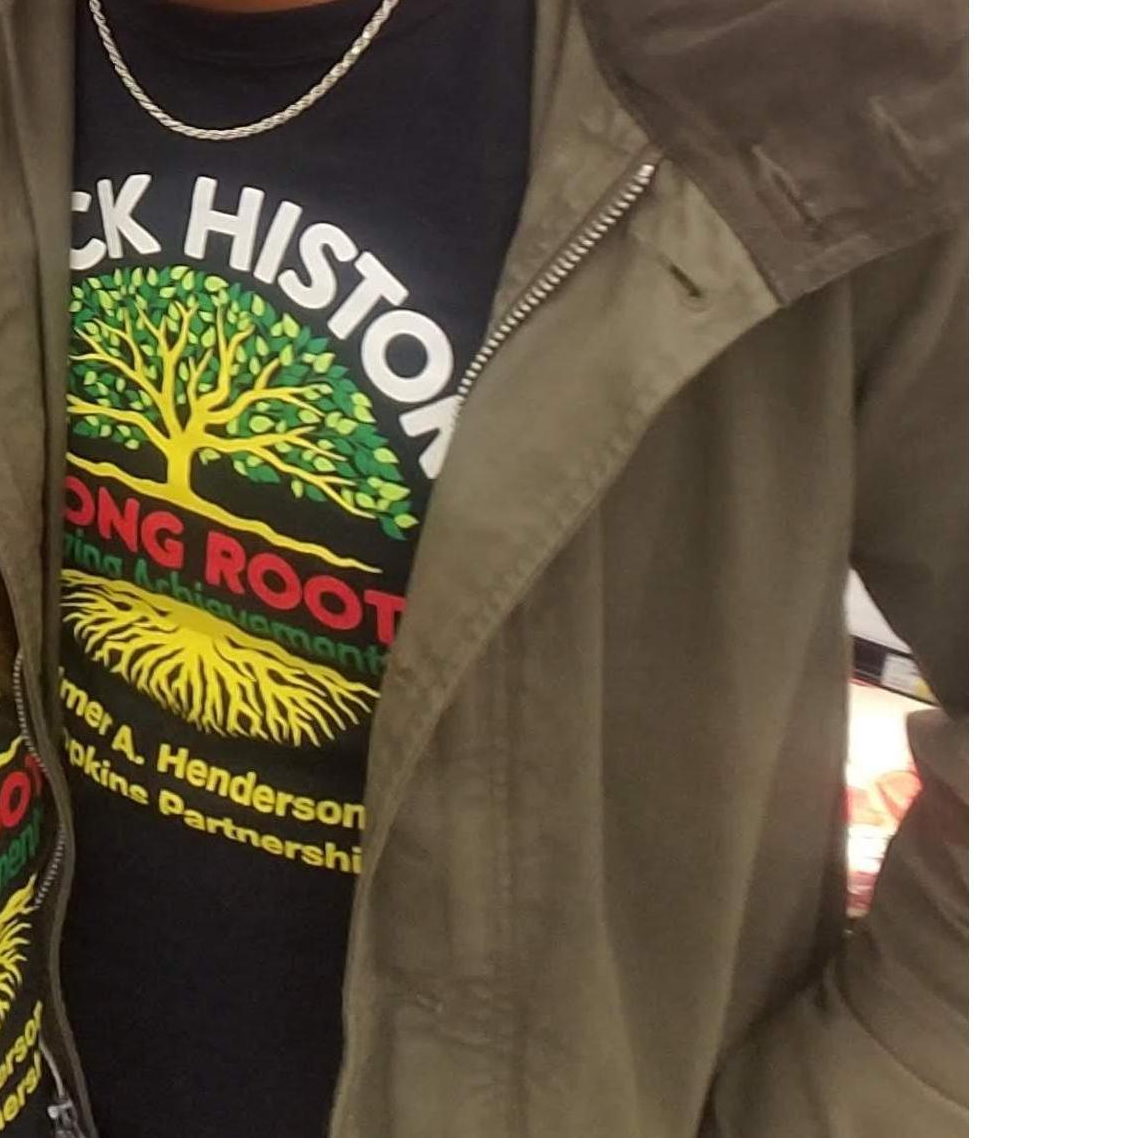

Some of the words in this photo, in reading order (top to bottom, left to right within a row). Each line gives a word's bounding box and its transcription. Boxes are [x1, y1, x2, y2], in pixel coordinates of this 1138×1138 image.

[205, 530, 407, 646] ROOT
[63, 726, 150, 805] pkins
[158, 788, 362, 874] Partnershi
[156, 742, 366, 830] Henderson
